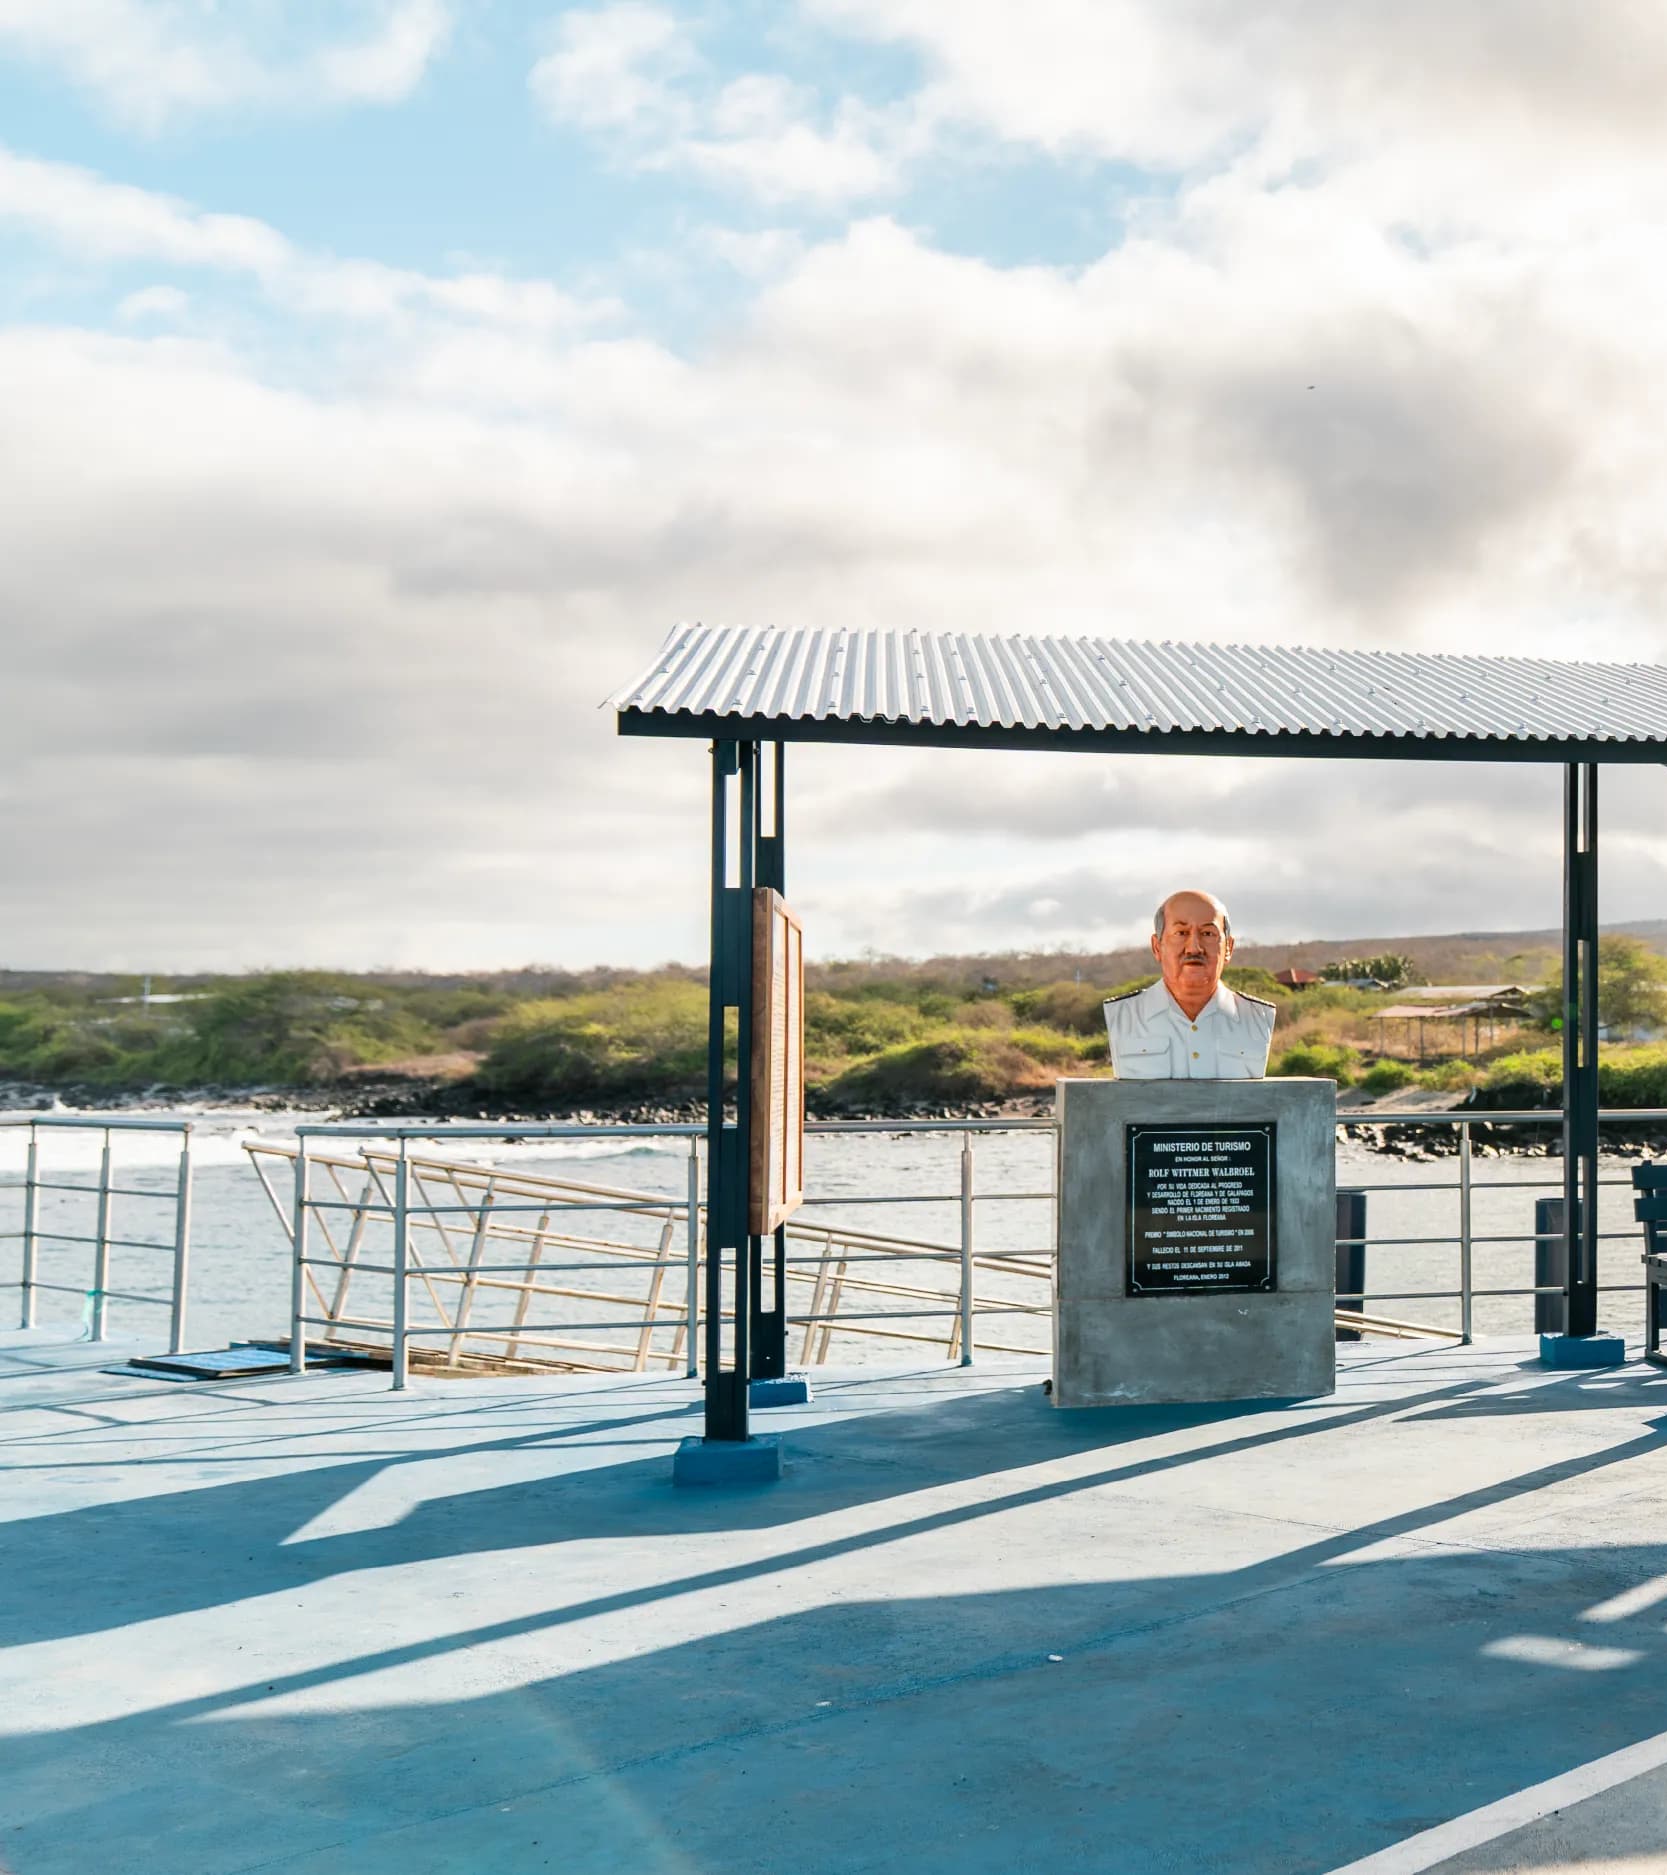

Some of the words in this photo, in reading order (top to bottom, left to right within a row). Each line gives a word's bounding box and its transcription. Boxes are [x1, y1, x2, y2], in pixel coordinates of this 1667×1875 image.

[1153, 1143, 1199, 1152] MINISTERIO
[1201, 1143, 1213, 1151] DE
[1215, 1142, 1251, 1151] TURISMO
[1149, 1169, 1169, 1178] ROLF
[1171, 1168, 1209, 1177] WITTMER
[1212, 1167, 1255, 1176] WALBROEL
